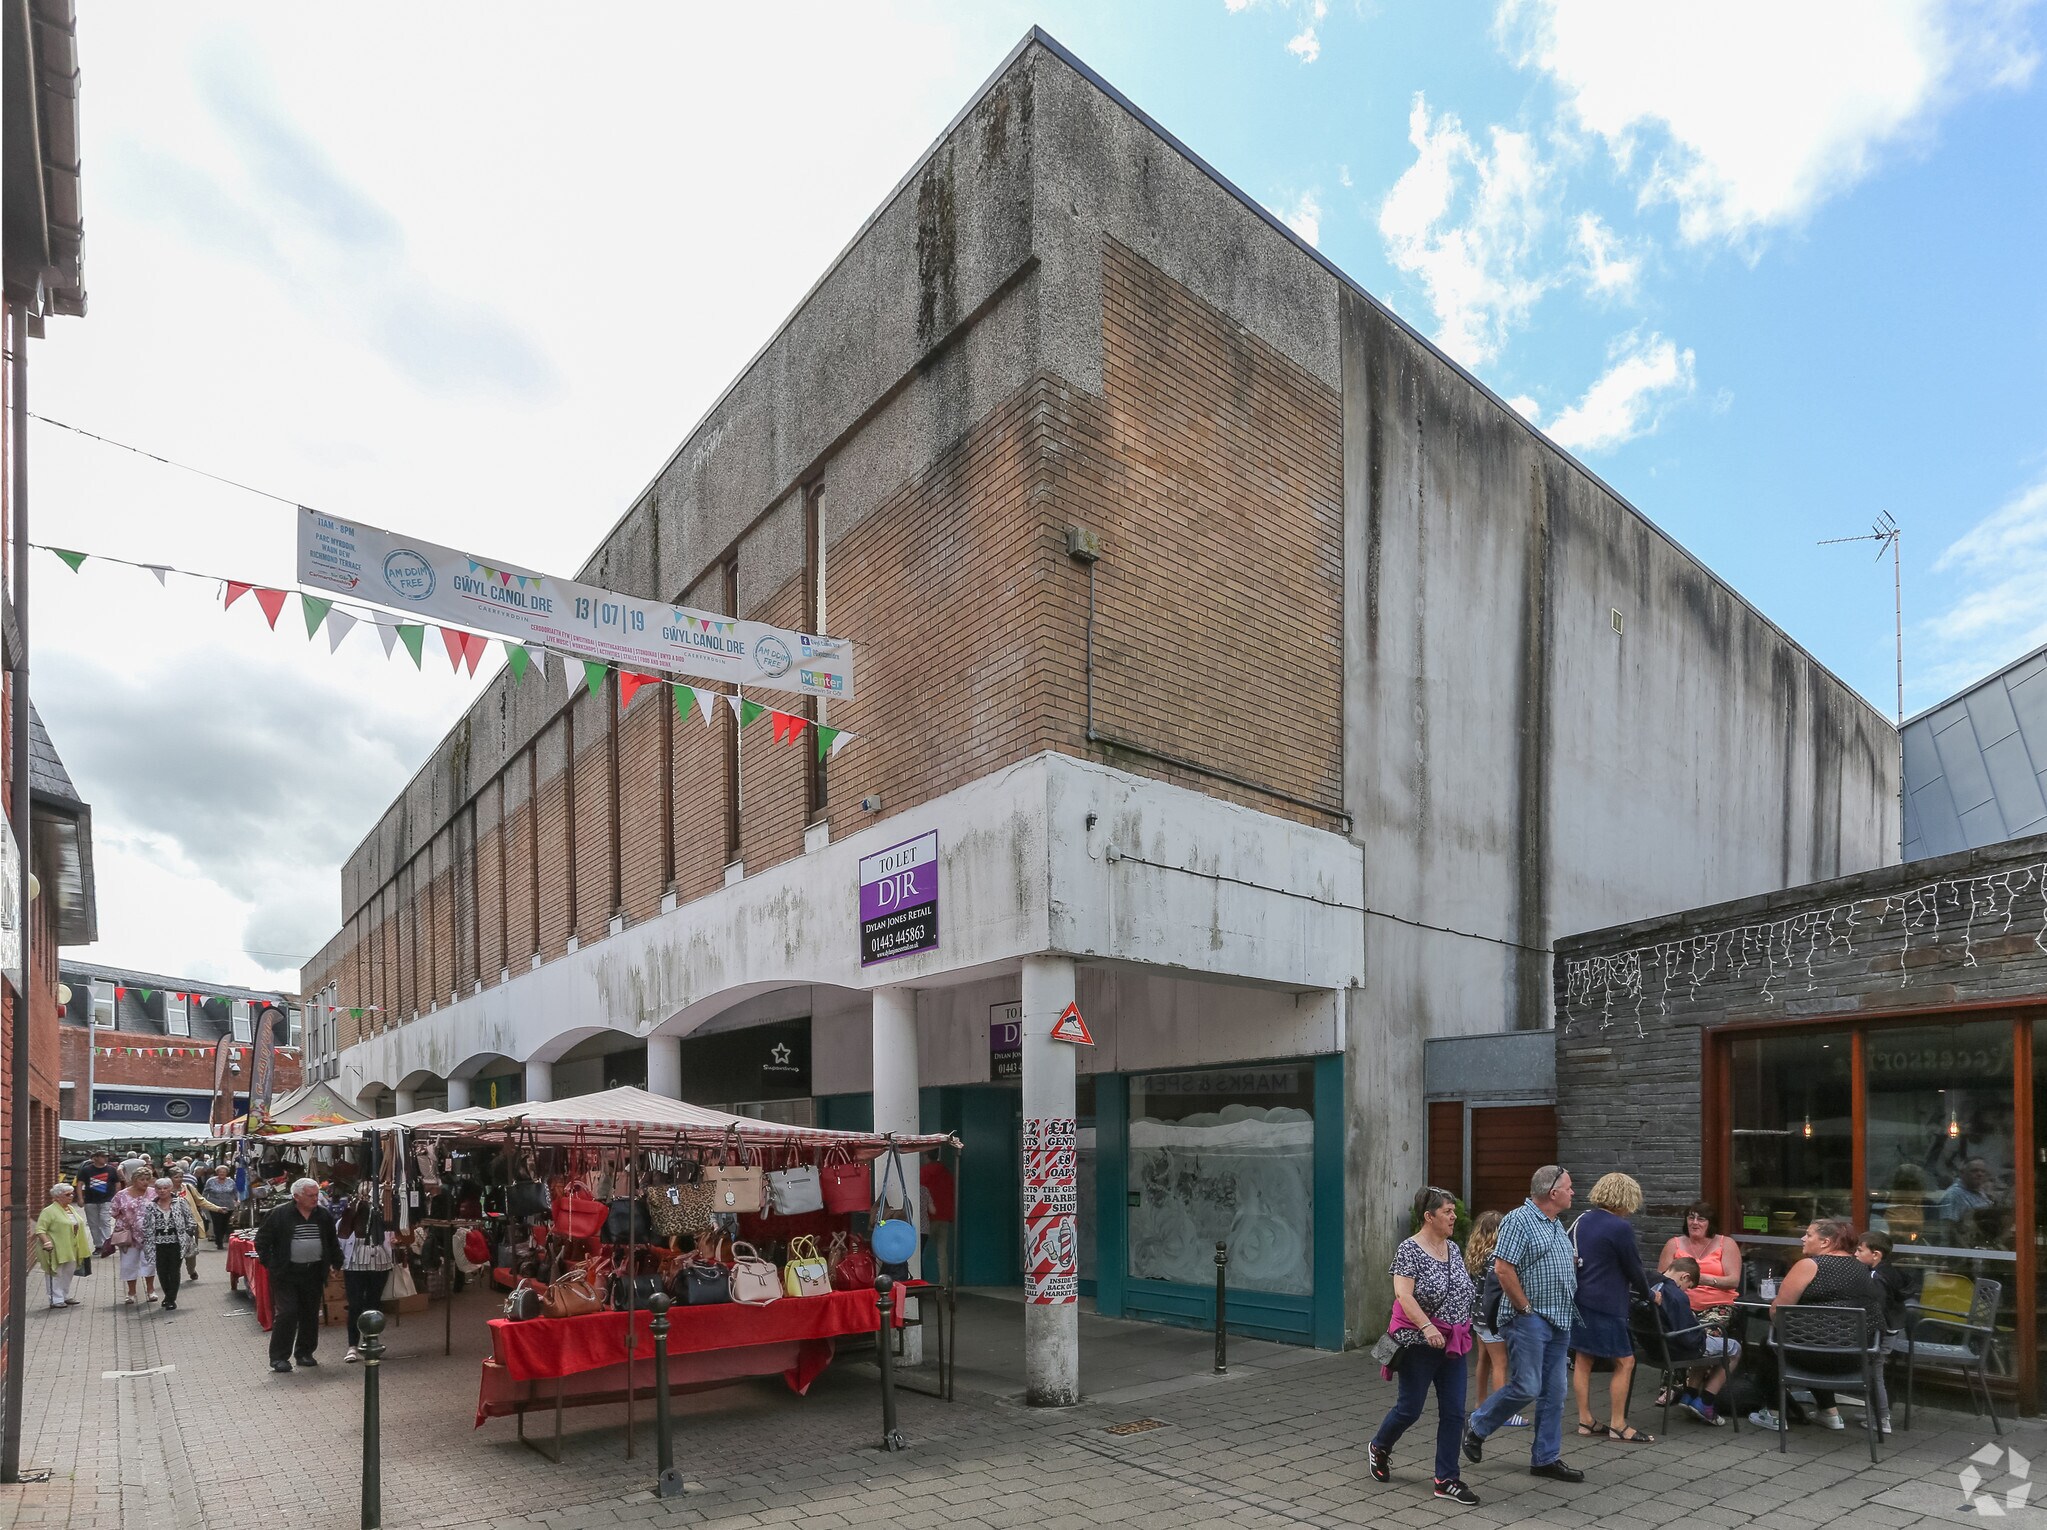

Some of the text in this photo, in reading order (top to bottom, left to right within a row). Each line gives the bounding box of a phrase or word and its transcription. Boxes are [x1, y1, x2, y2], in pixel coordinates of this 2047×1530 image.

[318, 518, 334, 530] 11AM
[340, 525, 355, 537] 8PM
[315, 532, 330, 544] PARC
[322, 544, 337, 554] WAUN
[310, 549, 338, 563] RICHMOND
[339, 558, 361, 571] TERRACE
[389, 566, 428, 577] AM DDIM
[400, 578, 423, 588] FREE
[454, 575, 553, 613] GŴYL CANOL DRE
[478, 605, 529, 622] CAERFYRDDIN
[546, 635, 556, 643] LIVE
[663, 625, 745, 655] GŴYL CANOL DRE
[758, 646, 788, 662] AM DDIM
[763, 659, 781, 669] FREE
[801, 672, 842, 689] Menter
[879, 847, 917, 873] TO LET
[877, 871, 919, 909] DJR
[871, 924, 925, 952] 01443 445863
[1005, 1008, 1017, 1019] TO
[1004, 1023, 1022, 1046] DJ
[1012, 1051, 1022, 1059] JON
[998, 1062, 1017, 1074] 01443
[101, 1101, 150, 1113] pharmacy
[1048, 1121, 1075, 1135] £12
[1047, 1137, 1076, 1146] GENTS
[1058, 1154, 1071, 1165] £8
[1043, 1194, 1076, 1203] BARBE
[1052, 1203, 1075, 1212] SHOP
